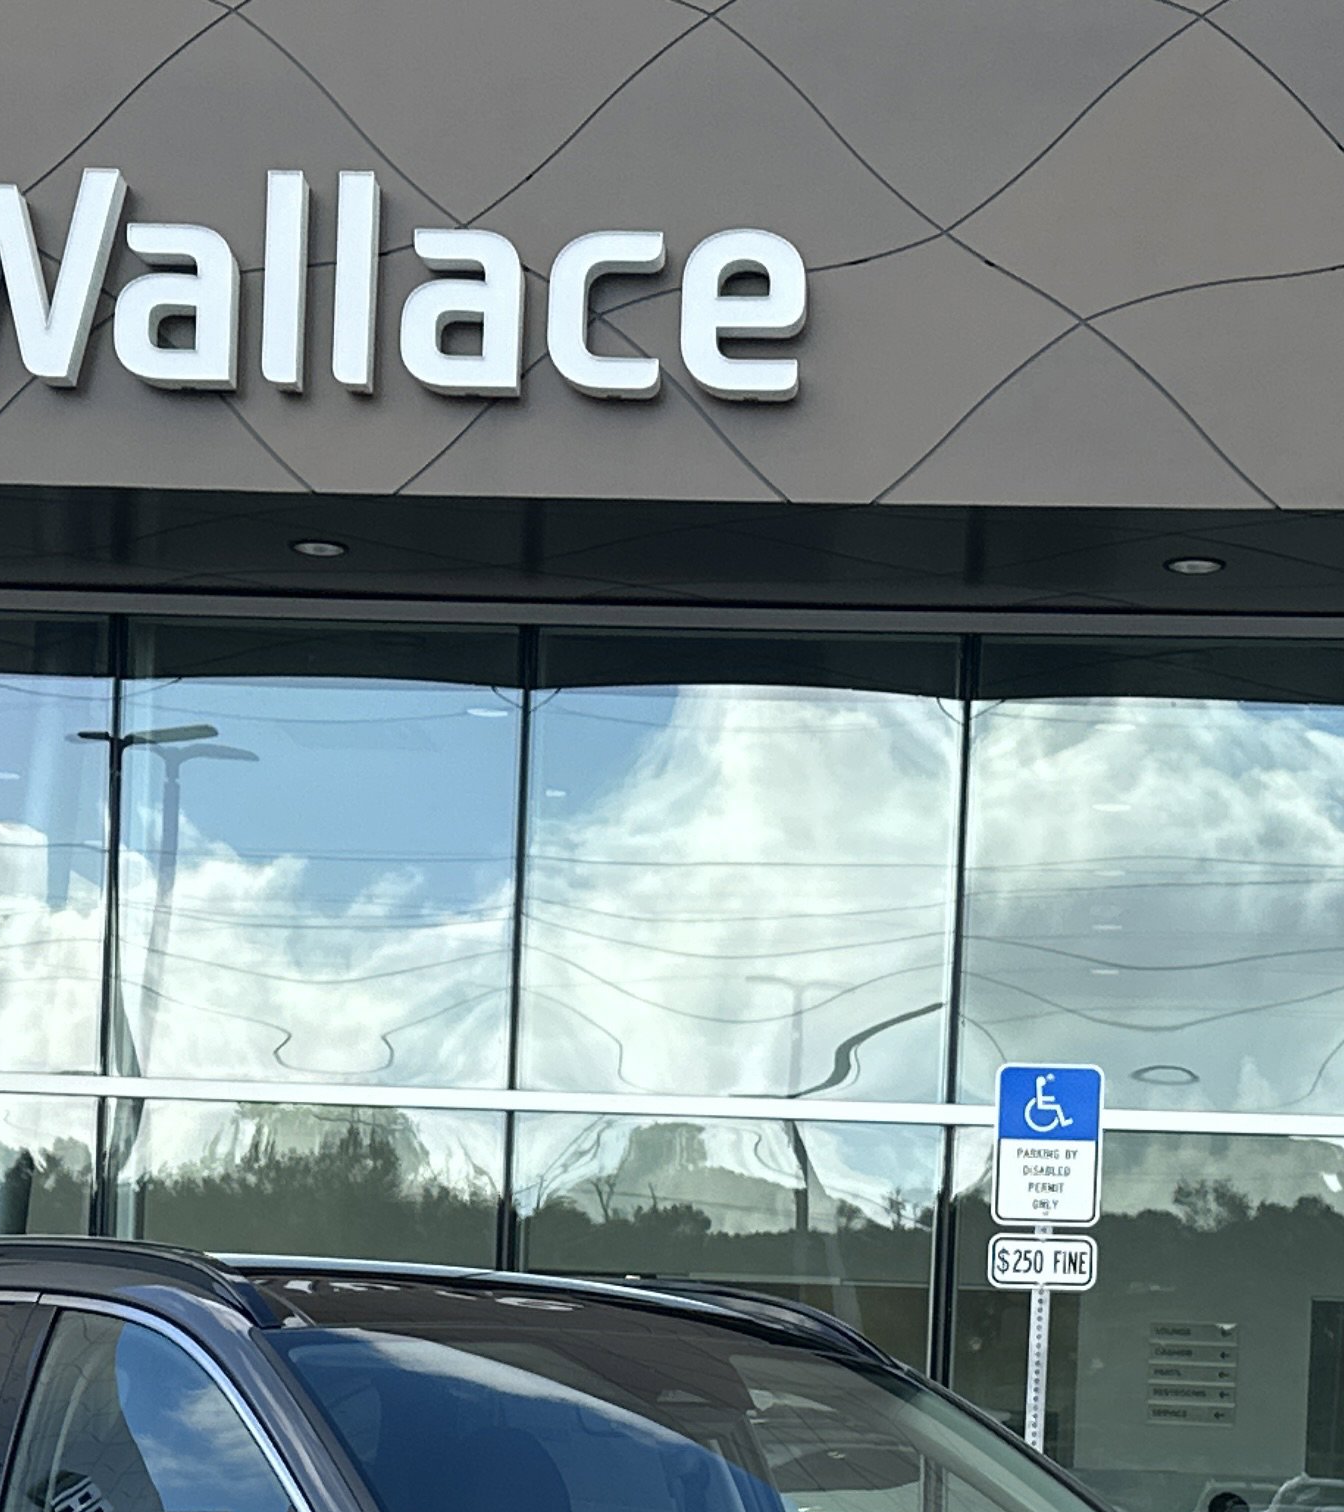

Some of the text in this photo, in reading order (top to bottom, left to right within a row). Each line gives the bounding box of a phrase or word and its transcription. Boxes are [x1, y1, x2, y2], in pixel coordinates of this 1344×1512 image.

[1016, 1148, 1078, 1161] PARKING BY
[1023, 1165, 1071, 1177] DISABLED
[1028, 1182, 1065, 1194] PERMIT
[996, 1247, 1088, 1275] $250 FINE
